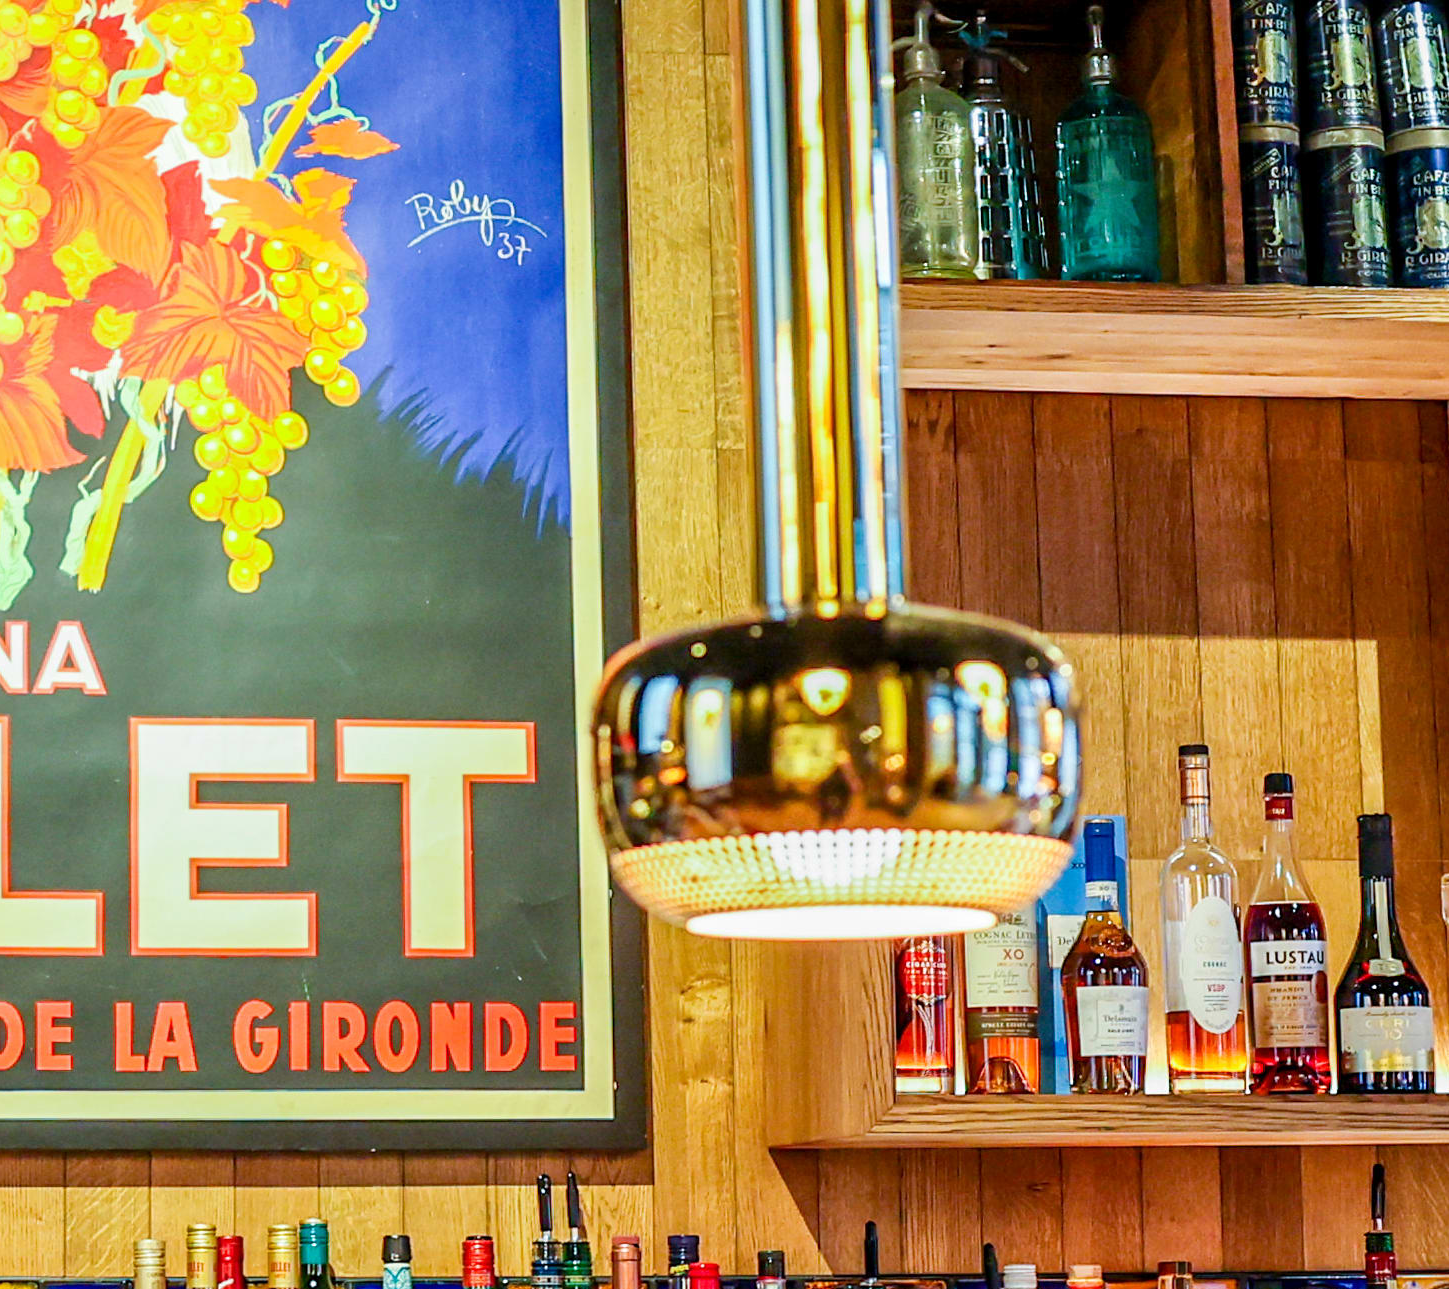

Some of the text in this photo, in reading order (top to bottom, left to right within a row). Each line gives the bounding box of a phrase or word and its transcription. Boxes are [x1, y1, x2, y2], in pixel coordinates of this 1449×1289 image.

[497, 232, 533, 266] 37
[1002, 948, 1025, 961] XO
[1265, 950, 1325, 965] LUSTAU
[113, 1000, 200, 1074] LA
[232, 997, 580, 1074] GIRONDE
